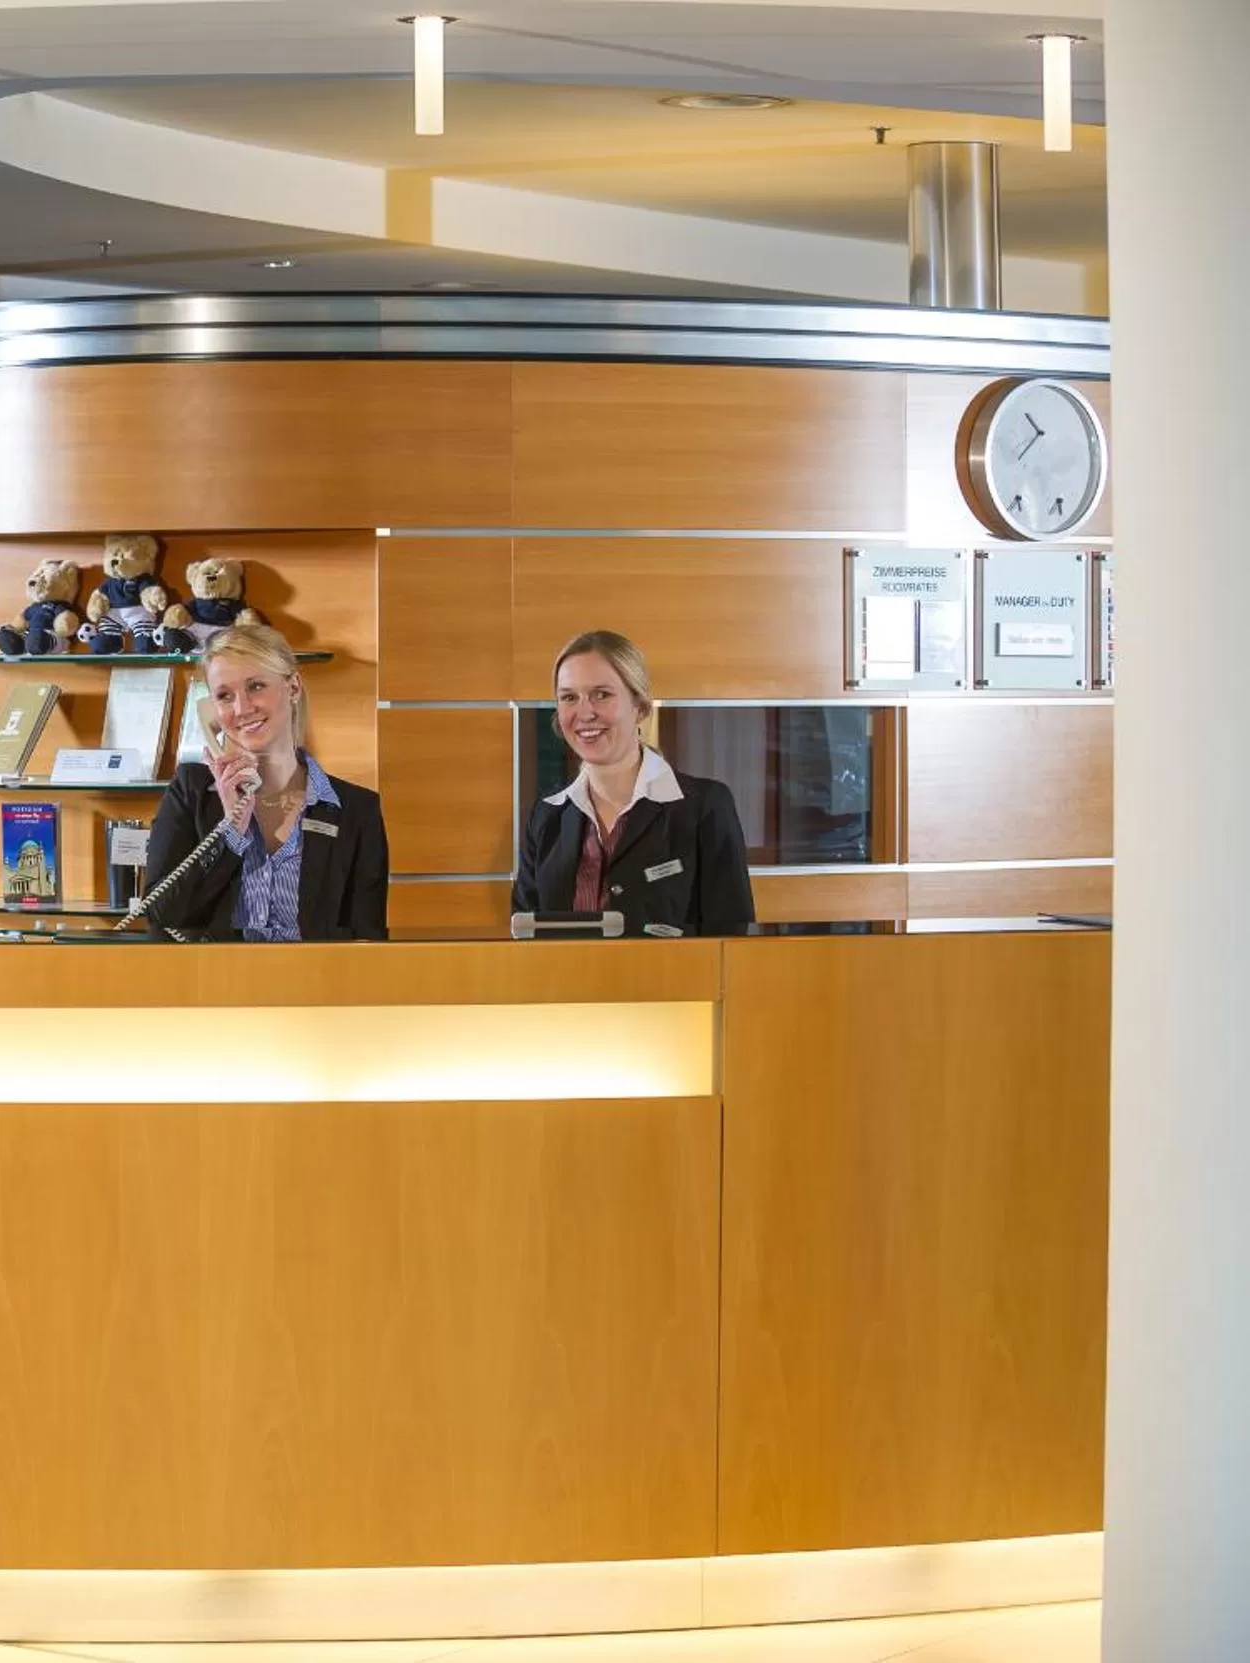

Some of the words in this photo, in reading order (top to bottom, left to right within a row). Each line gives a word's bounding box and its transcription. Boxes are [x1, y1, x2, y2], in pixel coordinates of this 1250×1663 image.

[872, 566, 947, 578] ZIMMERPREISE
[994, 595, 1041, 608] MANAGER
[1050, 596, 1075, 608] DUTY
